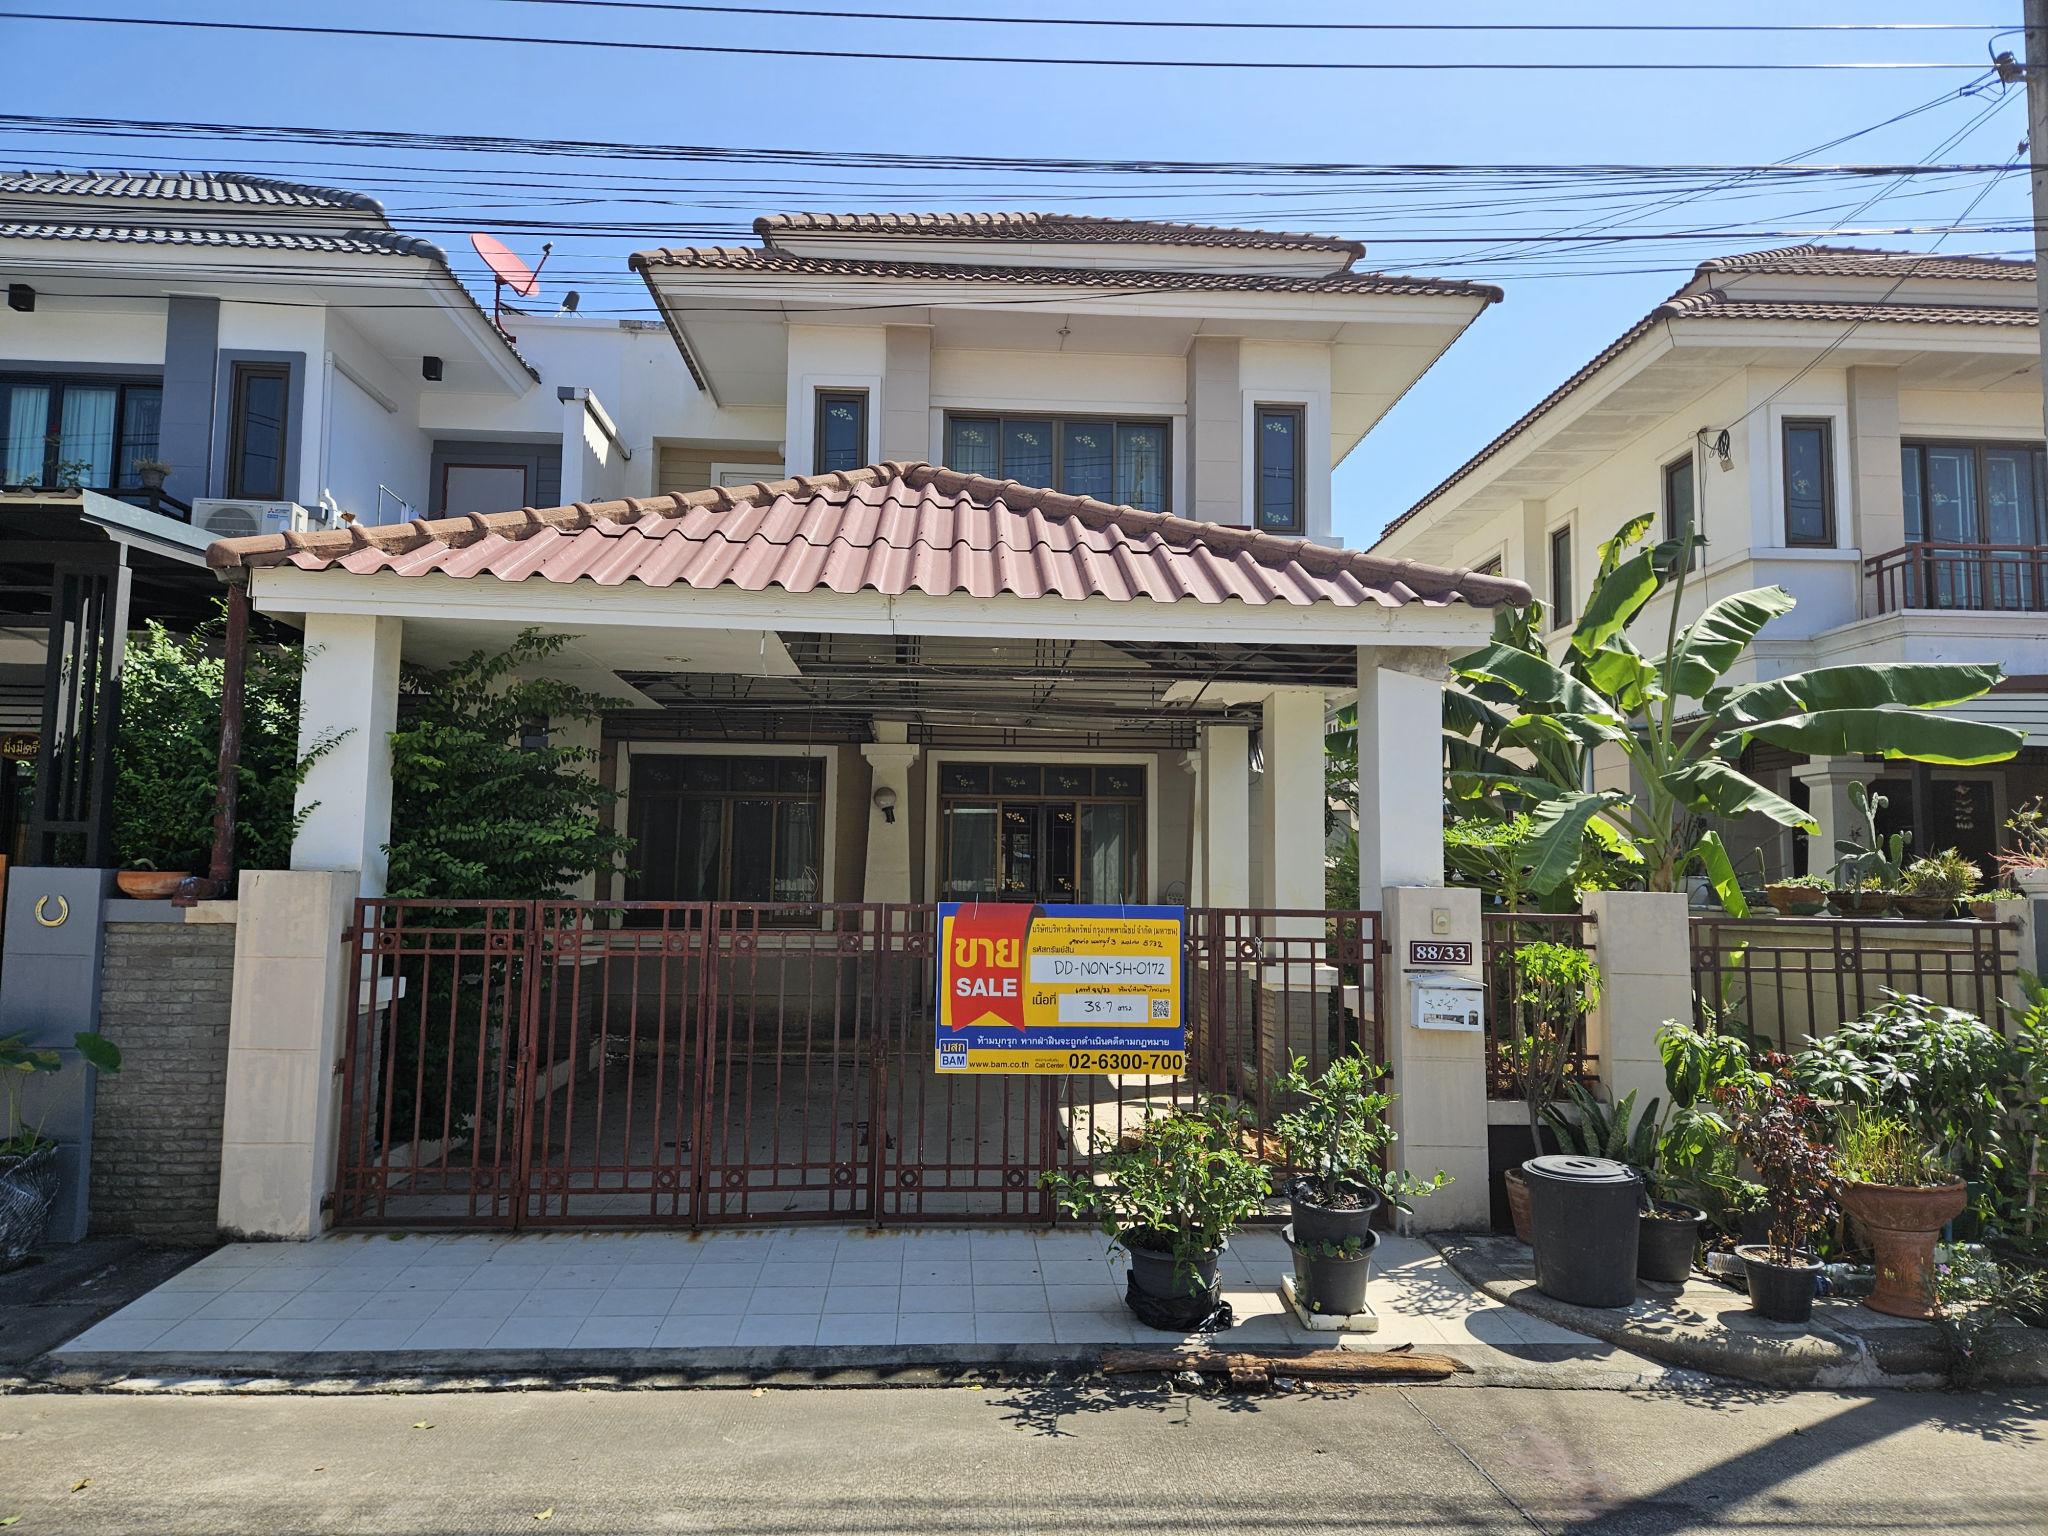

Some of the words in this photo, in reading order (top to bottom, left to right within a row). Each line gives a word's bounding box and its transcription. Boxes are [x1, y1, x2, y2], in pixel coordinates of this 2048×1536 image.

[955, 938, 1020, 968] ขาย
[1416, 946, 1466, 960] 88/33
[1054, 960, 1165, 976] DD-NON-SH-0172
[956, 978, 1017, 997] SALE
[1032, 991, 1057, 1006] เนื้อที่
[942, 1042, 965, 1053] บสก
[977, 1035, 1018, 1048] ห้ามบุกรุก
[1020, 1035, 1170, 1049] หากฝ่าฝืนจะถูกดำเนินคดีตามกฎหมาย
[942, 1056, 965, 1066] BAM
[969, 1060, 1029, 1069] www.bam.co.th
[1069, 1053, 1183, 1070] 02-6300-700
